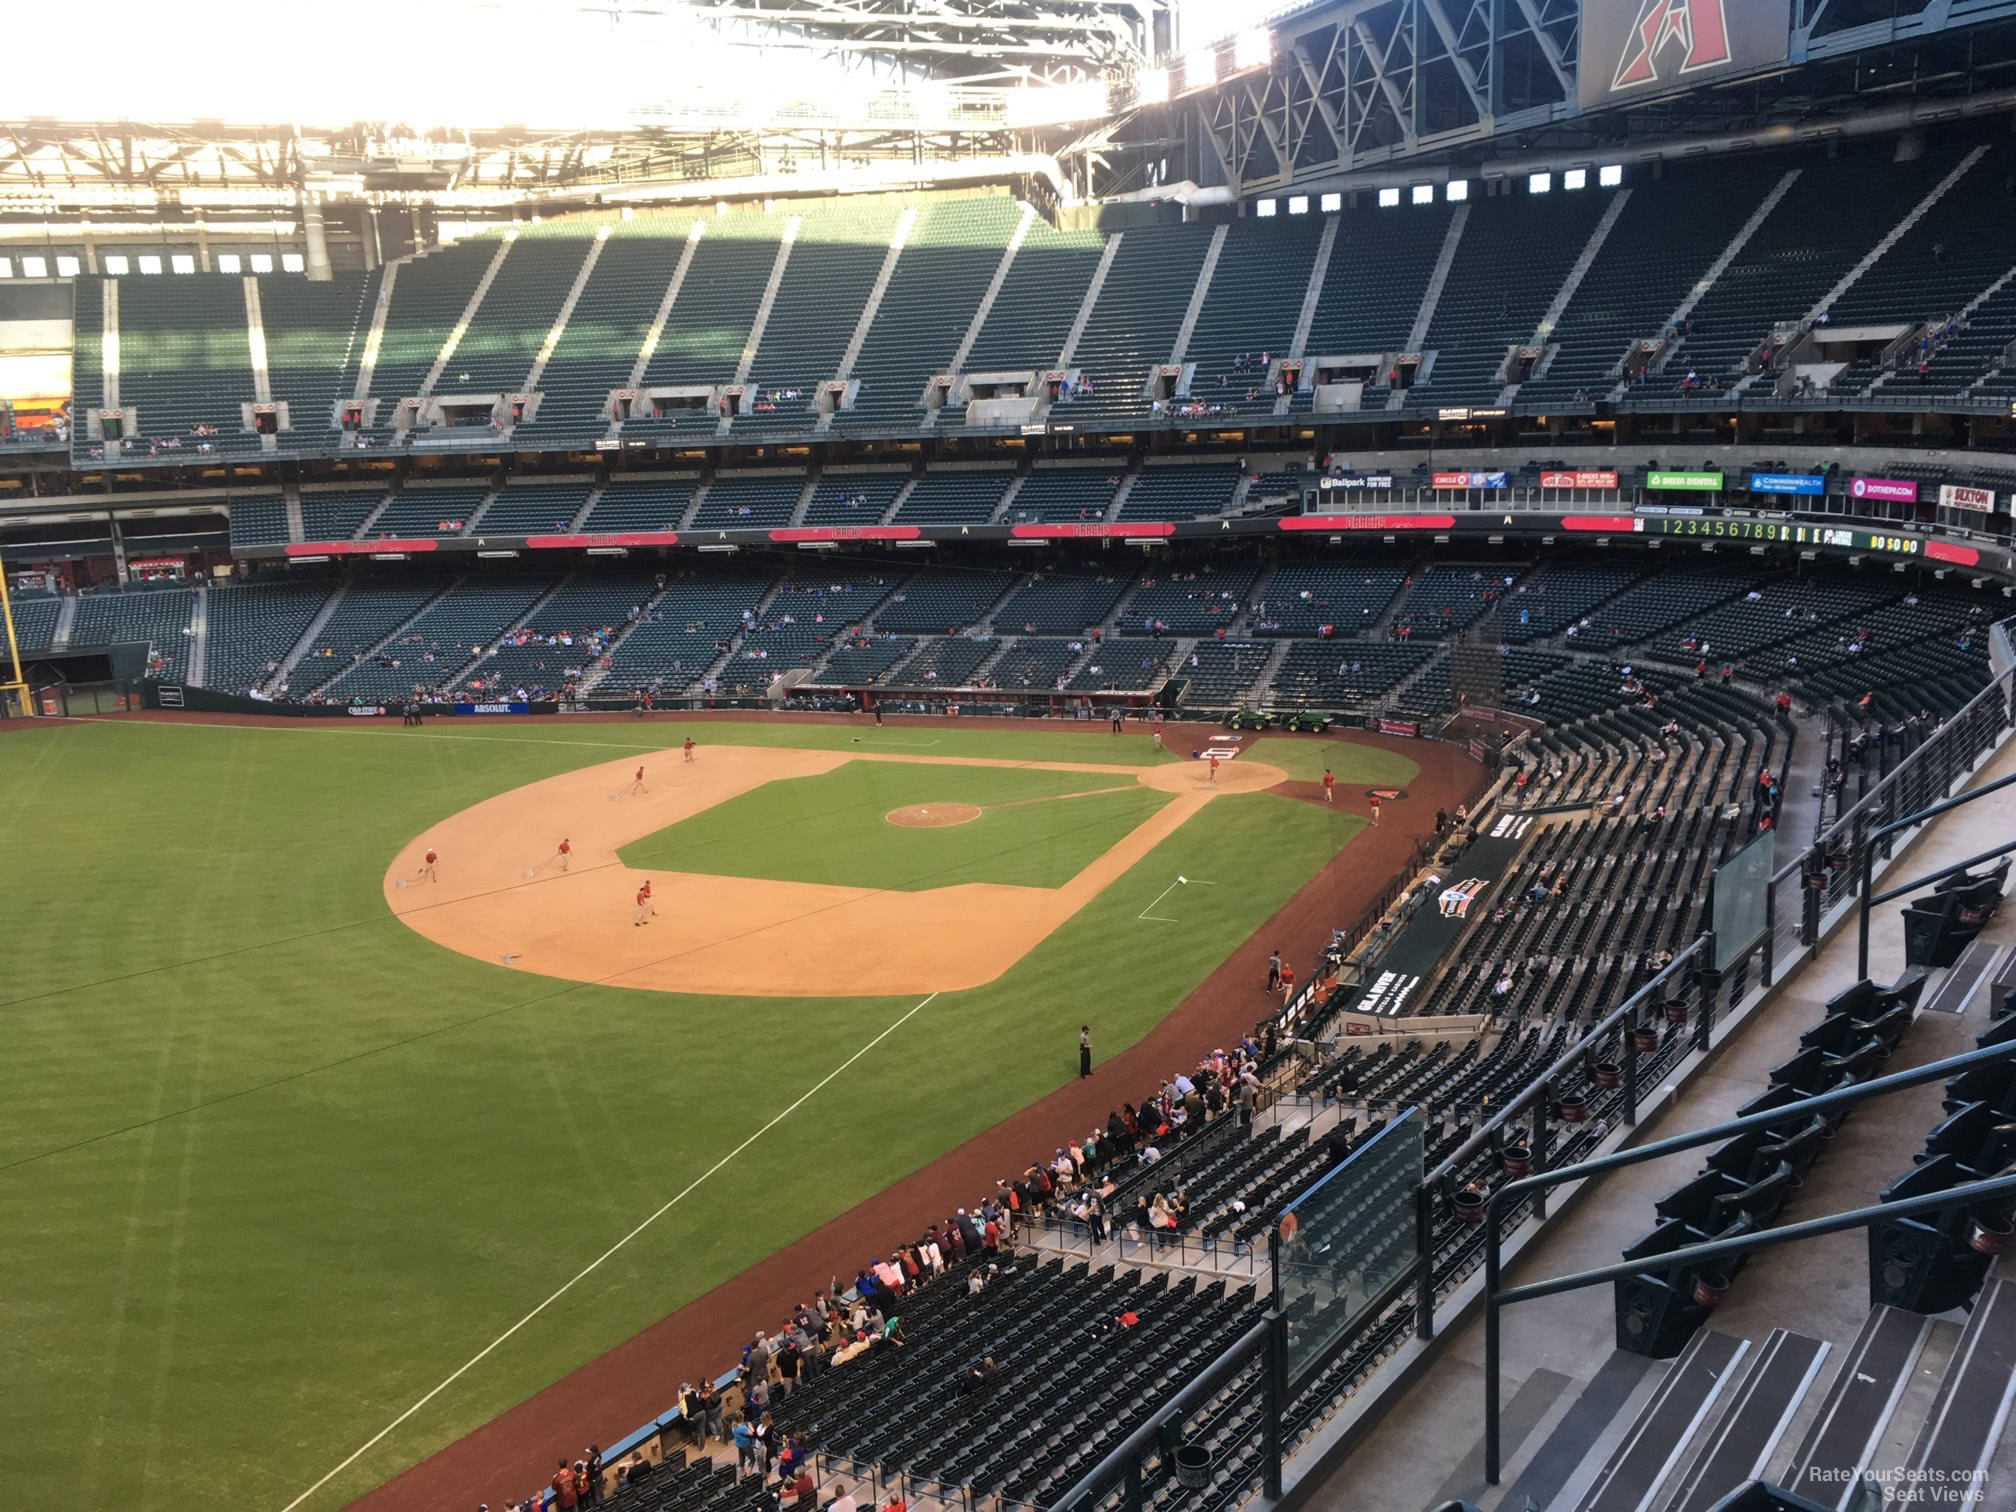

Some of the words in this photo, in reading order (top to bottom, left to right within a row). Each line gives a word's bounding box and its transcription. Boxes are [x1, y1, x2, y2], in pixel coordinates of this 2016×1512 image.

[1332, 478, 1365, 488] Ballpark
[1662, 477, 1685, 485] DELTA
[1686, 477, 1718, 486] DENTAL
[1763, 477, 1822, 487] COMMONWEALTH
[1954, 487, 1989, 505] SEXTON
[1663, 519, 1668, 533] 1
[1674, 519, 1682, 533] 2
[1688, 520, 1697, 534] 3
[1701, 521, 1711, 535] 4
[1715, 522, 1724, 536] 5
[1729, 522, 1738, 536] 6
[1743, 523, 1751, 537] 7
[1755, 524, 1763, 538] 8
[1767, 525, 1775, 539] 9
[1369, 969, 1397, 994] RIVER
[1357, 993, 1382, 1011] GILA
[1374, 996, 1392, 1013] HOTELS
